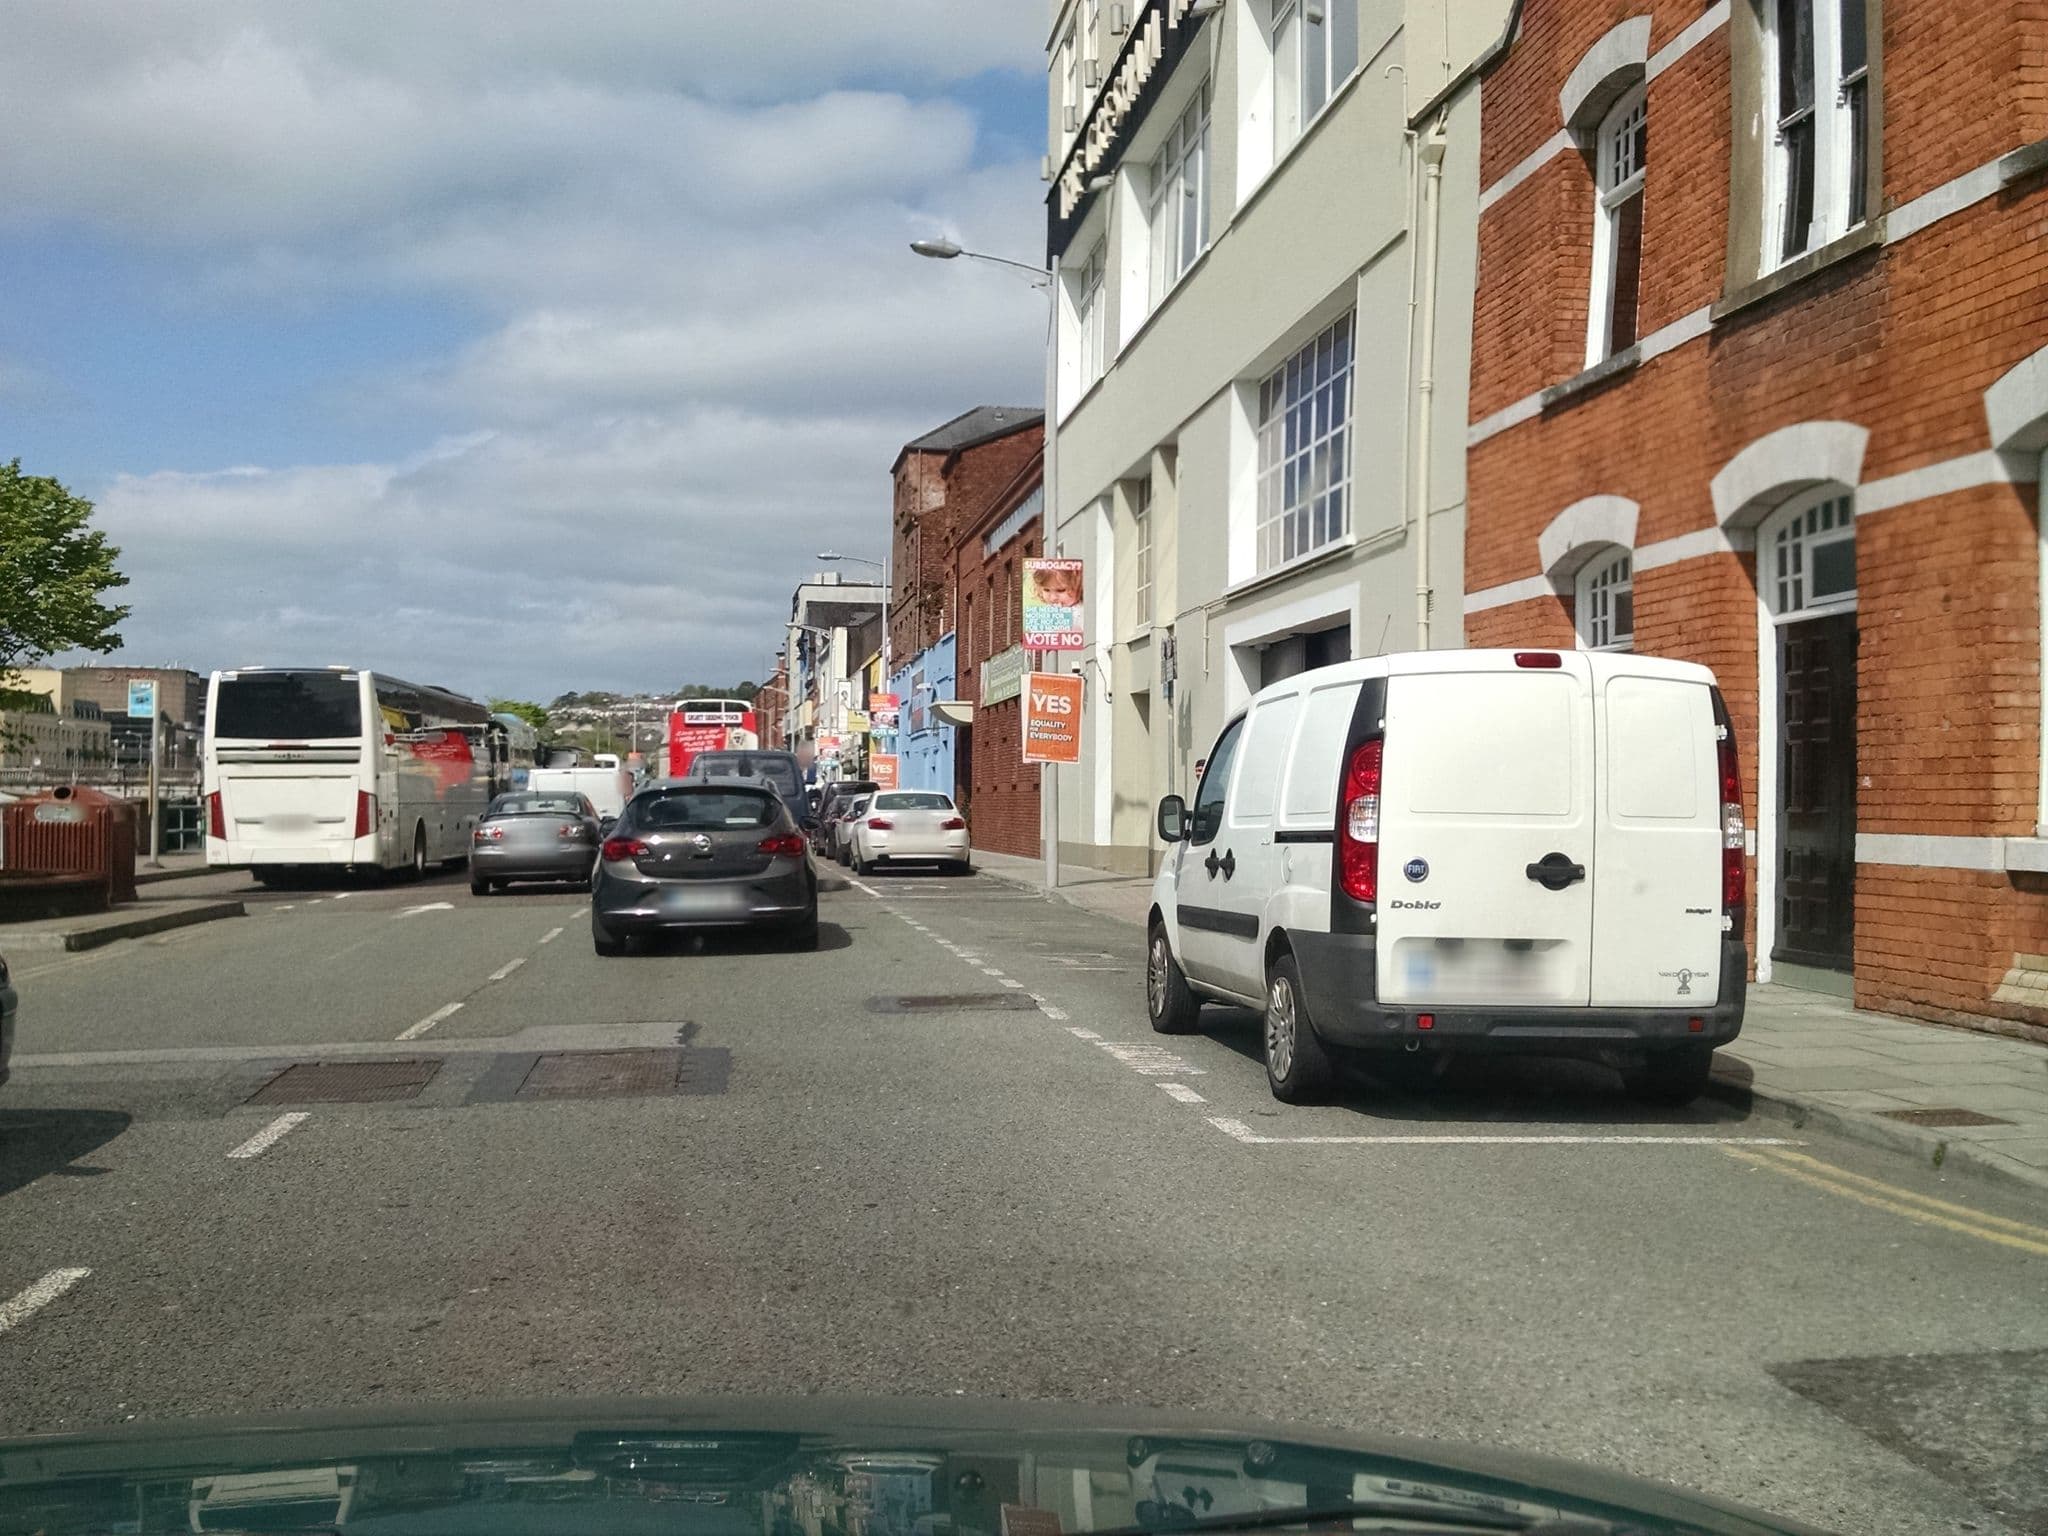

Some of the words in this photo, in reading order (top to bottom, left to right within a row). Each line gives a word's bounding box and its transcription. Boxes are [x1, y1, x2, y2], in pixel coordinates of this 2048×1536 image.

[1024, 560, 1082, 571] SURROGACY?
[1024, 633, 1058, 646] VOTE
[1061, 633, 1083, 646] NO
[1032, 693, 1072, 714] YES
[1030, 719, 1066, 729] EQUALITY
[1029, 732, 1073, 742] EVERYBODY
[873, 764, 893, 774] YES
[1408, 864, 1425, 873] FIAT
